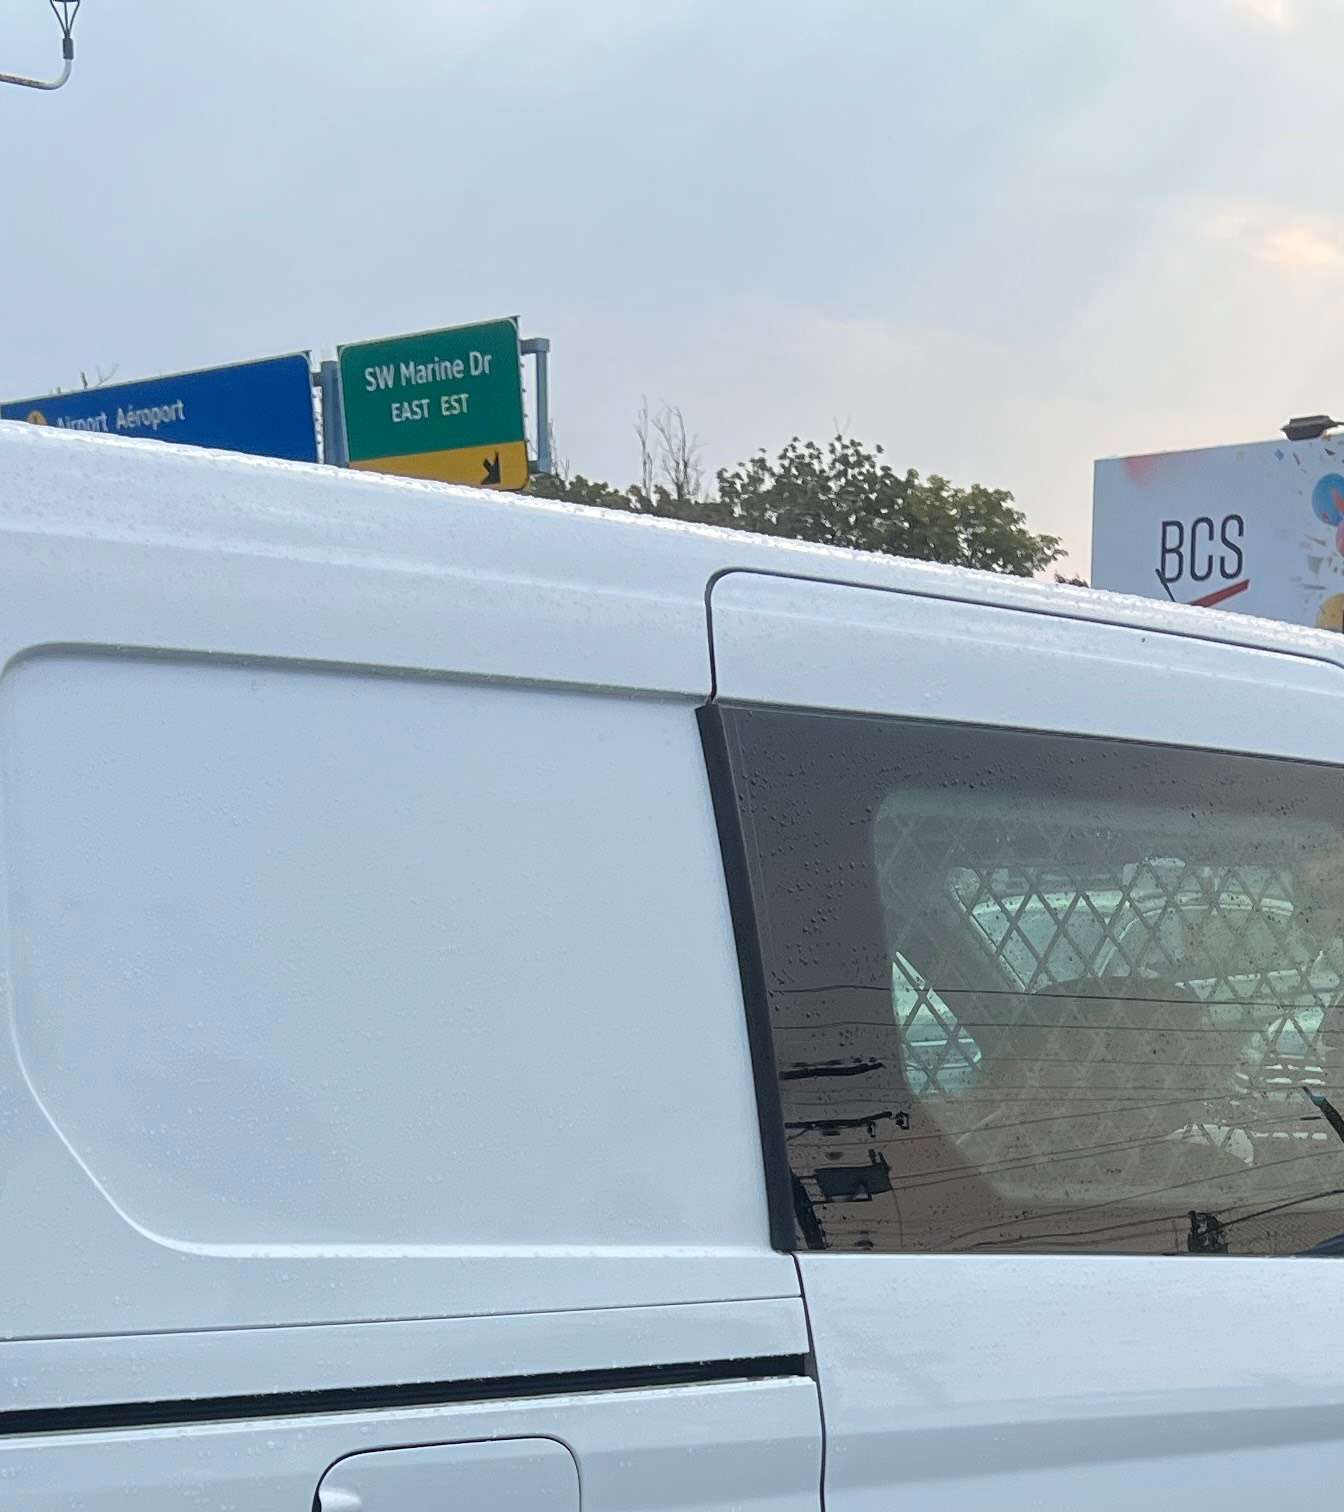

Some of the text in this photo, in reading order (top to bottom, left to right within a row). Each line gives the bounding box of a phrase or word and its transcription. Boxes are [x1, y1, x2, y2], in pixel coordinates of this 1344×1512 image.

[364, 350, 493, 392] SW Marine Dr
[116, 399, 186, 430] Aéroport
[391, 393, 469, 423] EAST EST
[1161, 514, 1244, 583] BCS
